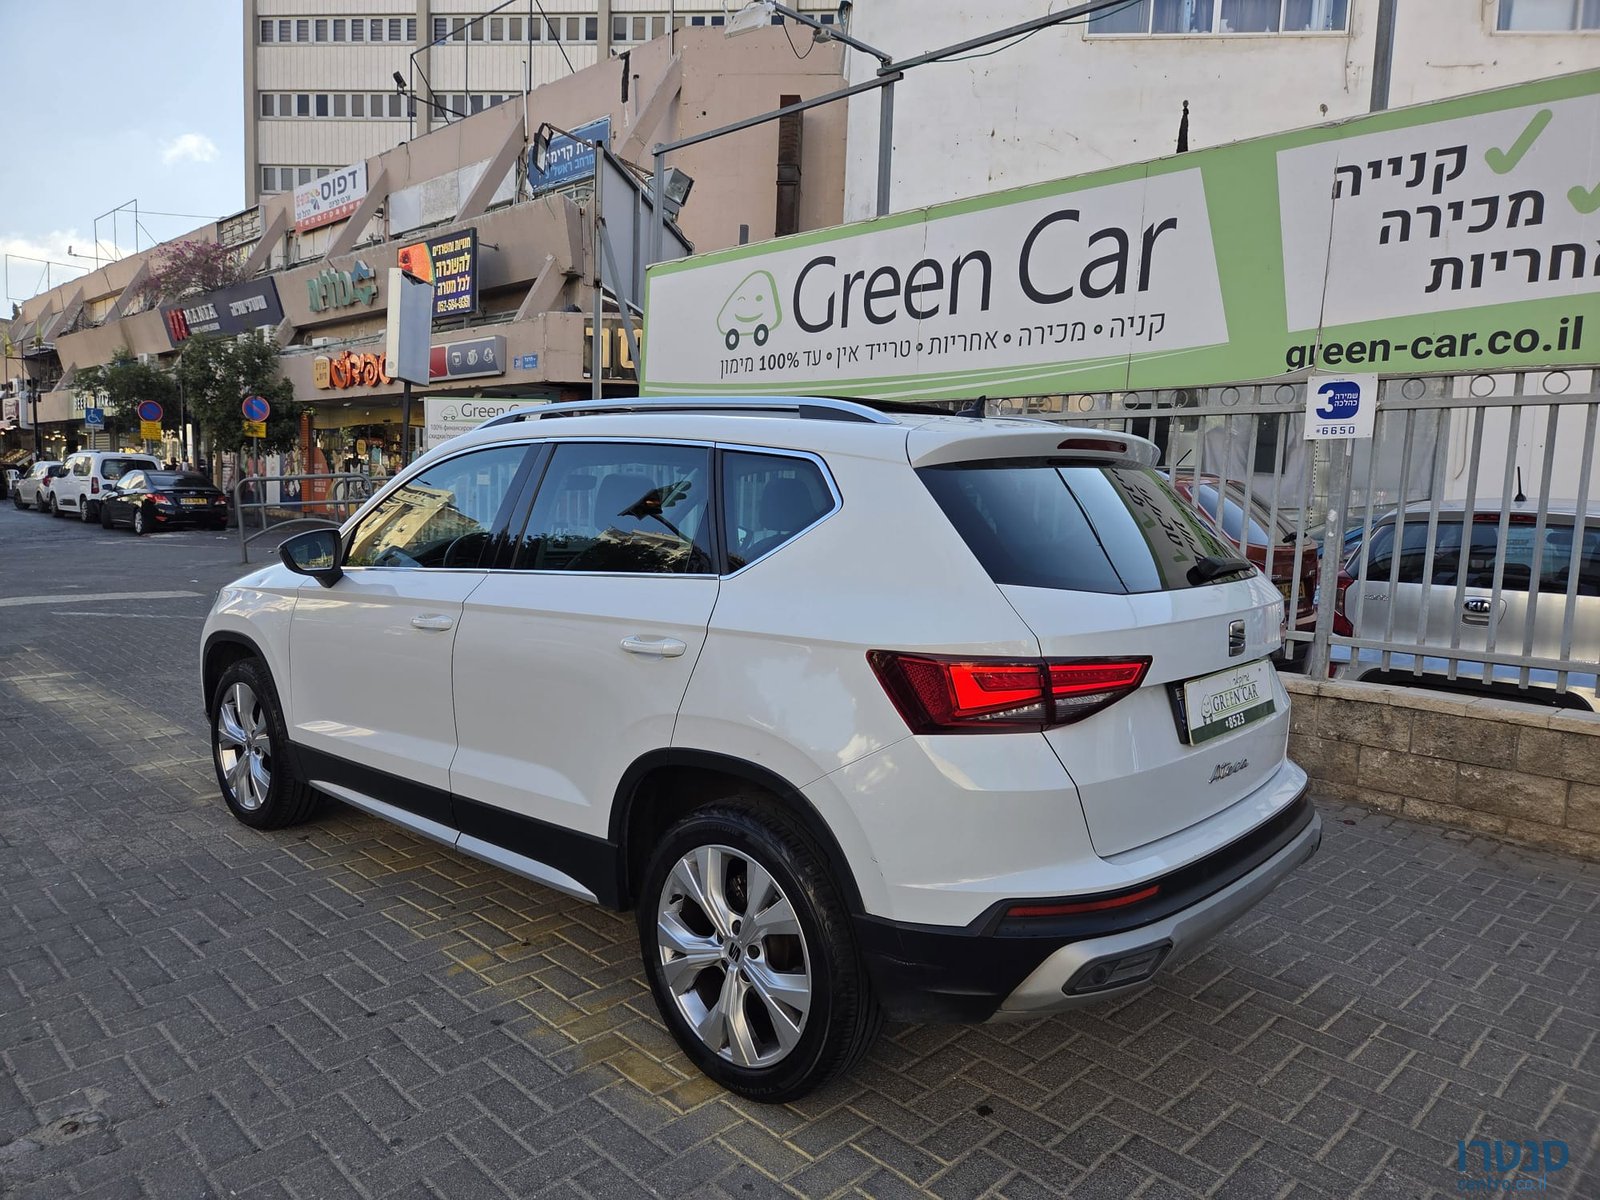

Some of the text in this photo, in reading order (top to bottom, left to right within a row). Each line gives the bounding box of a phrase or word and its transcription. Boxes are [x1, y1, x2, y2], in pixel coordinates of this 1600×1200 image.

[576, 139, 593, 155] בת
[321, 170, 357, 201] דפוס
[1331, 144, 1468, 200] קנייה
[1379, 189, 1545, 245] מכירה
[435, 252, 471, 278] להשכרה
[793, 209, 1177, 333] Green Car
[437, 274, 471, 296] לכל מטרה
[720, 313, 1165, 379] קניה מכירה אחריות טרייד אין עד 100% מימון
[1286, 315, 1584, 373] green-car.co.il
[461, 403, 505, 418] Green
[1468, 601, 1491, 612] KIA
[1212, 684, 1258, 712] GREEN CAR
